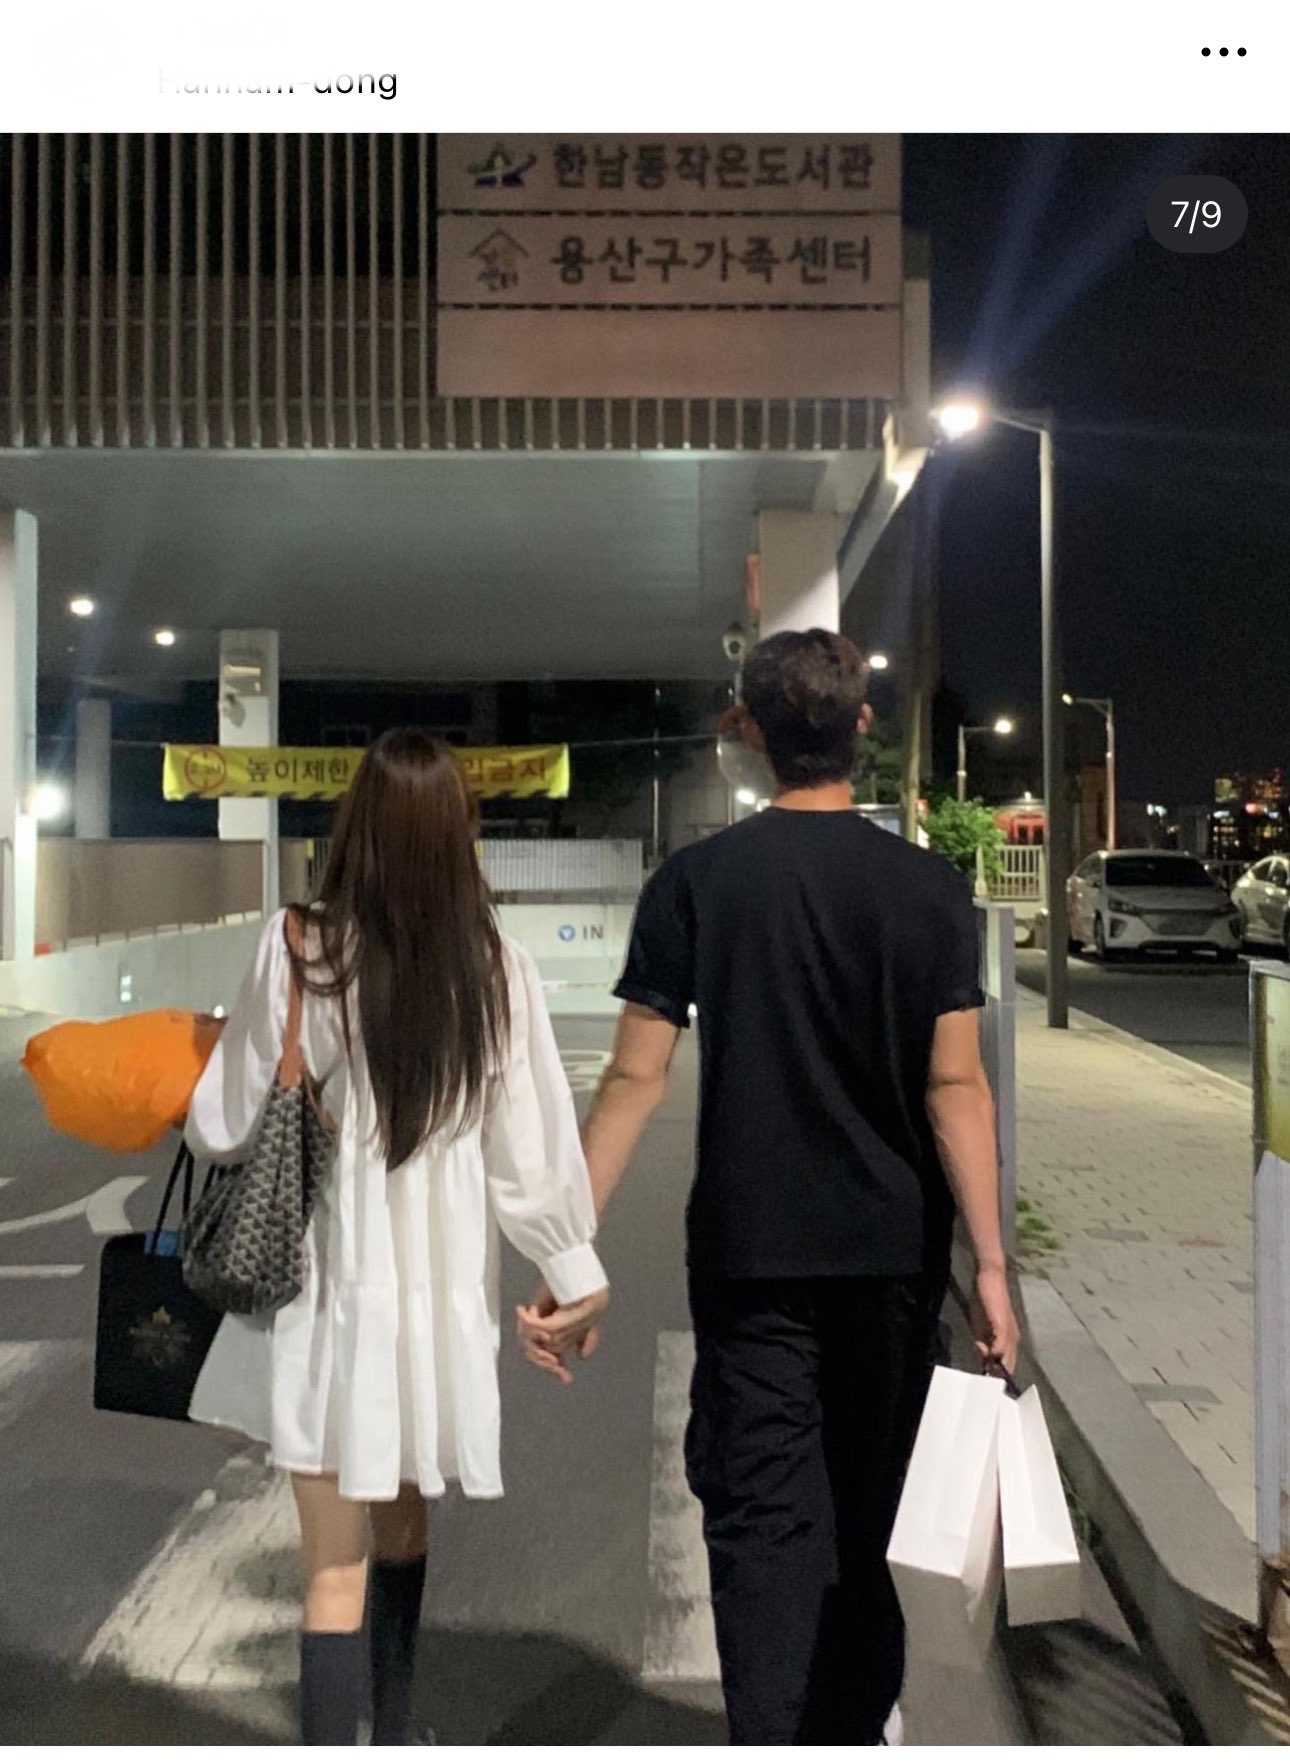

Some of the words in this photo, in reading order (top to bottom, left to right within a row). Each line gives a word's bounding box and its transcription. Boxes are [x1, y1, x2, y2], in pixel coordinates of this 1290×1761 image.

[551, 235, 872, 285] 용산구가족센터
[246, 757, 349, 784] 높이제한
[461, 756, 546, 783] 입금지
[582, 924, 604, 941] IN
